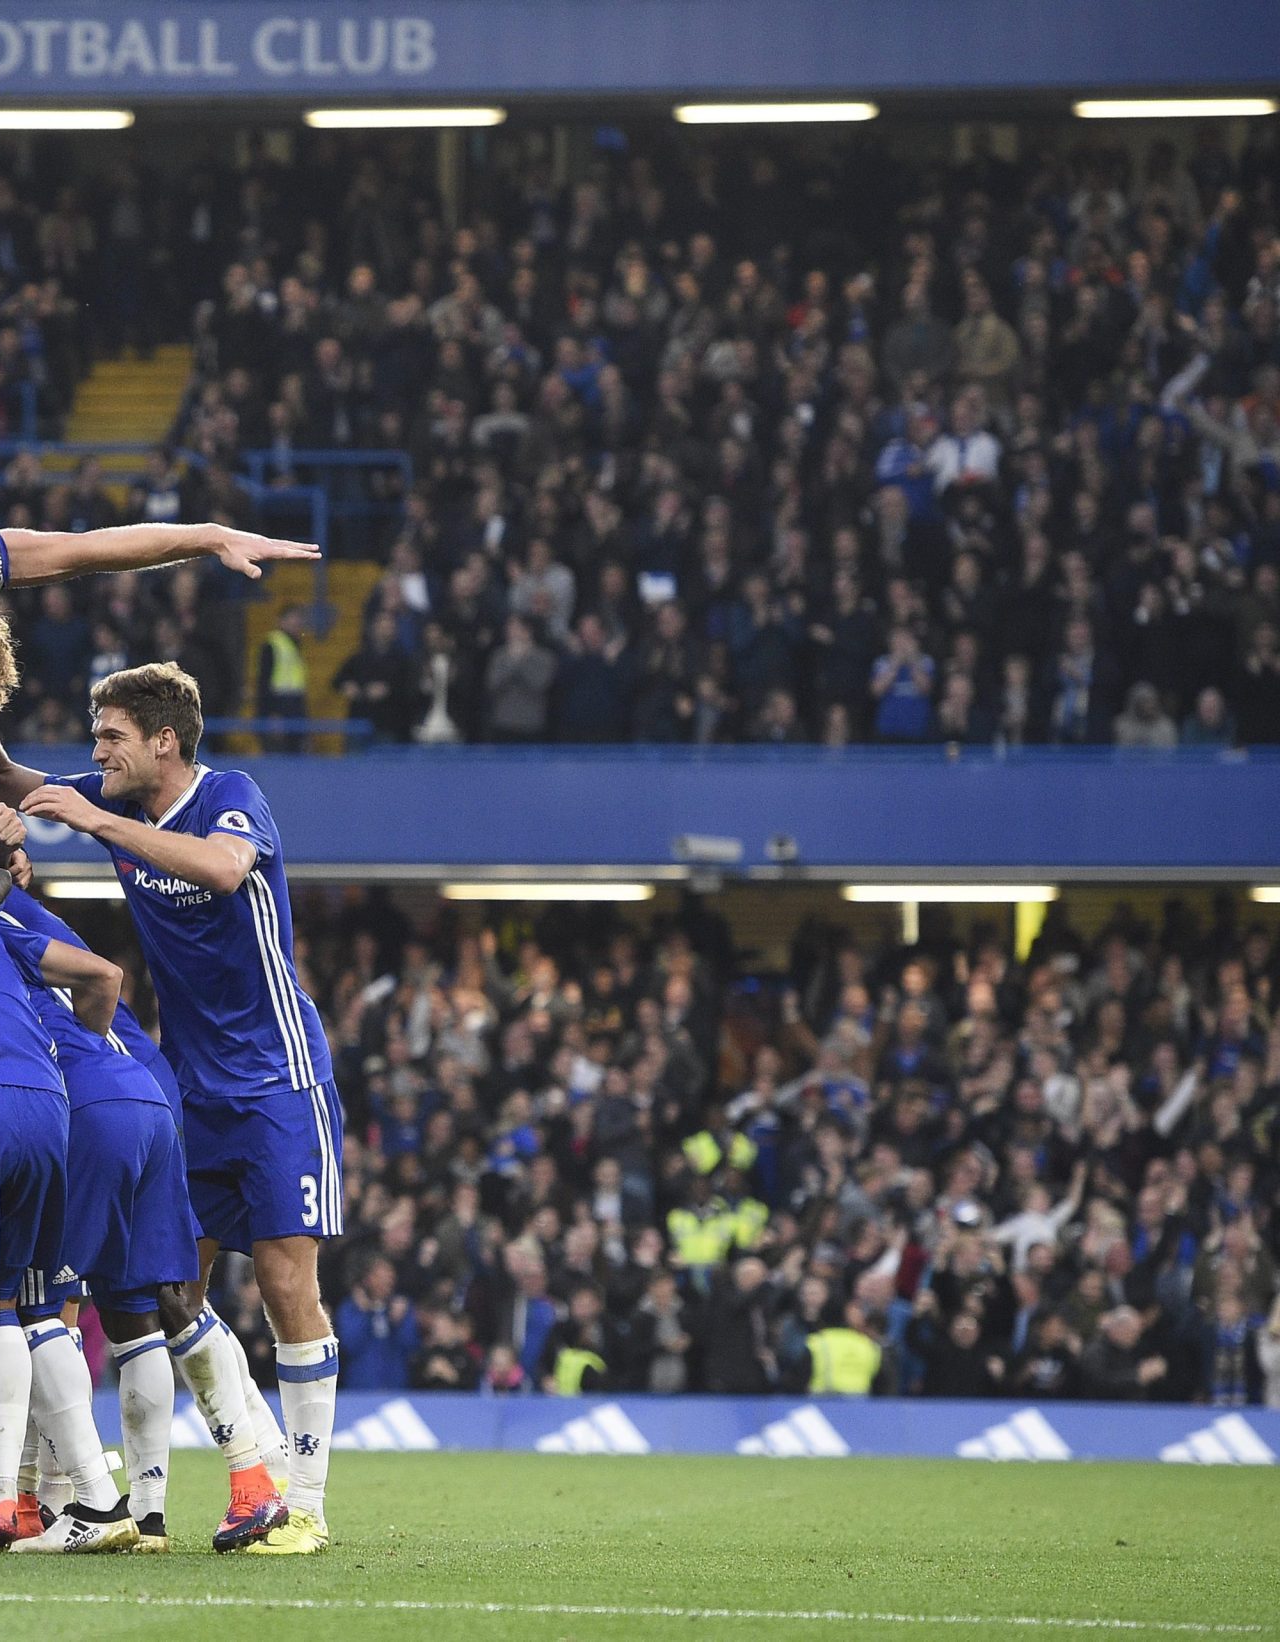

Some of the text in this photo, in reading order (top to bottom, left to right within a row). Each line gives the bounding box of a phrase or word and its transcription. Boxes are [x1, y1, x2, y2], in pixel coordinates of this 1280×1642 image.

[251, 17, 437, 77] CLUB
[175, 890, 212, 907] TYRES
[300, 1175, 319, 1227] 3
[52, 1273, 79, 1285] adidas
[64, 1527, 101, 1553] adidas
